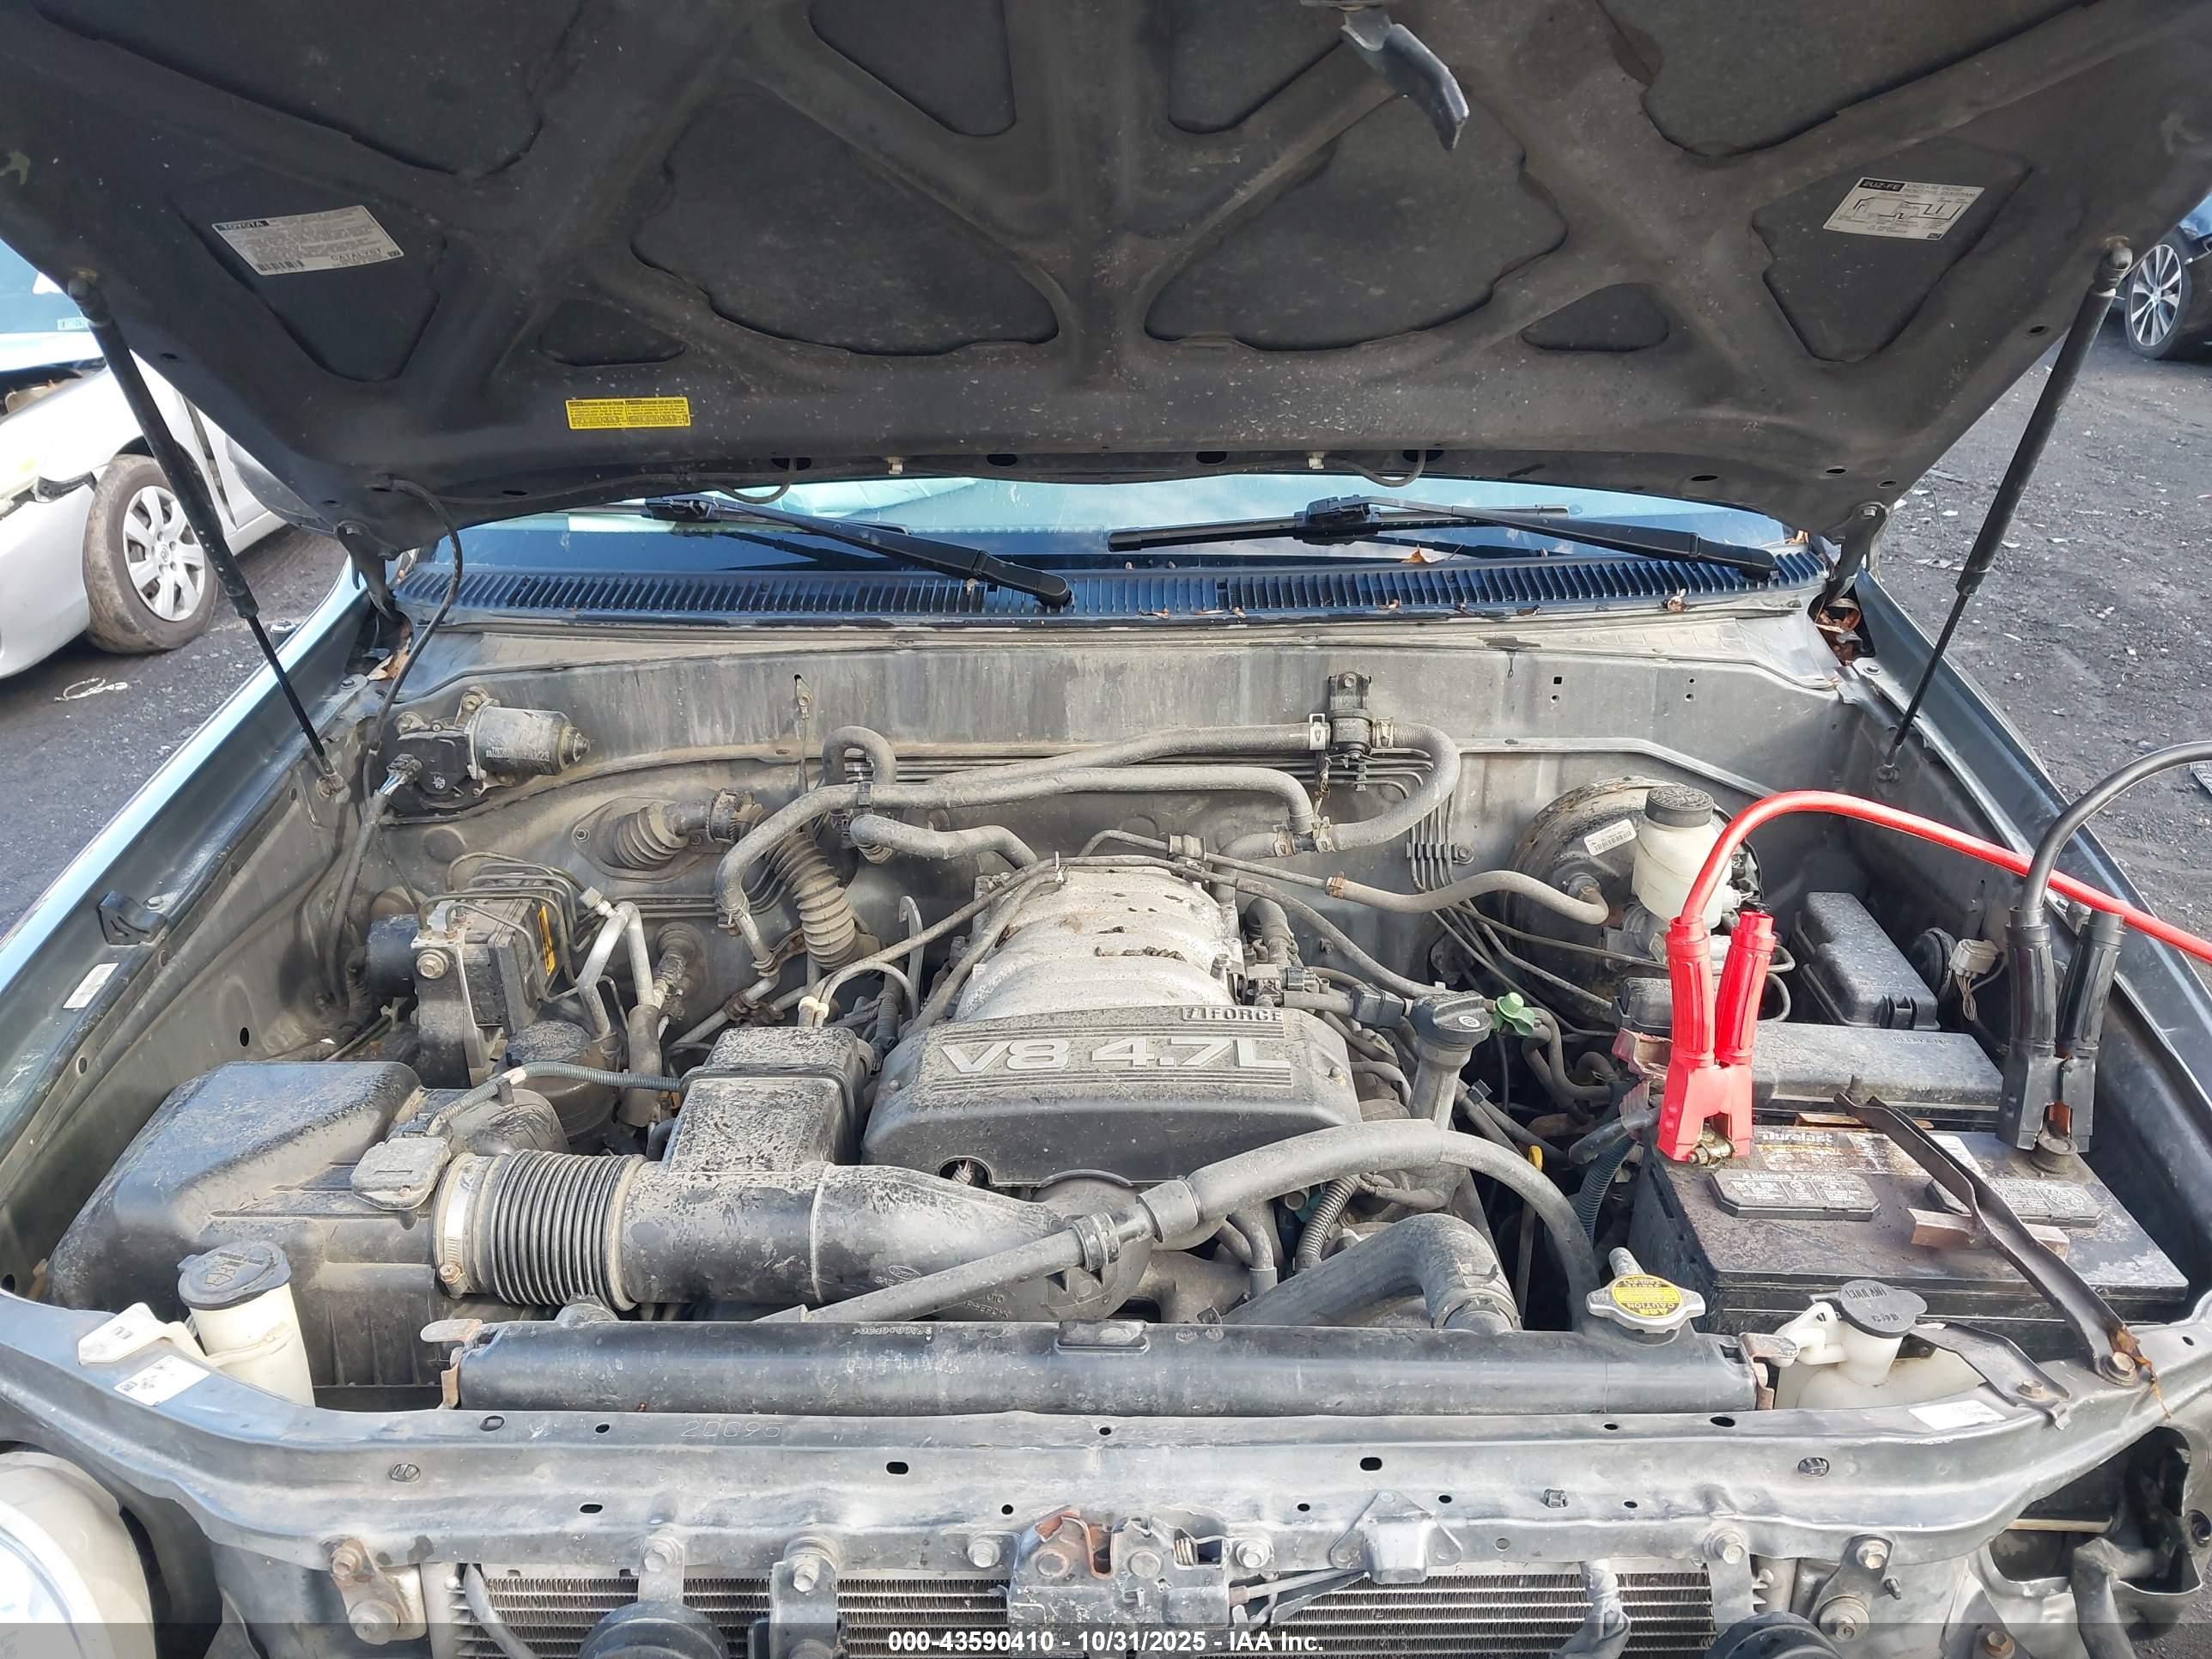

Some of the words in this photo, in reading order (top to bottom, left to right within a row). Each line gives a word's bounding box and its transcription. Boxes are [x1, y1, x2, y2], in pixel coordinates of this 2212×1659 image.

[941, 1039, 1071, 1073] V8
[1091, 1037, 1291, 1069] 4.7L
[1760, 1130, 1833, 1143] Duralast
